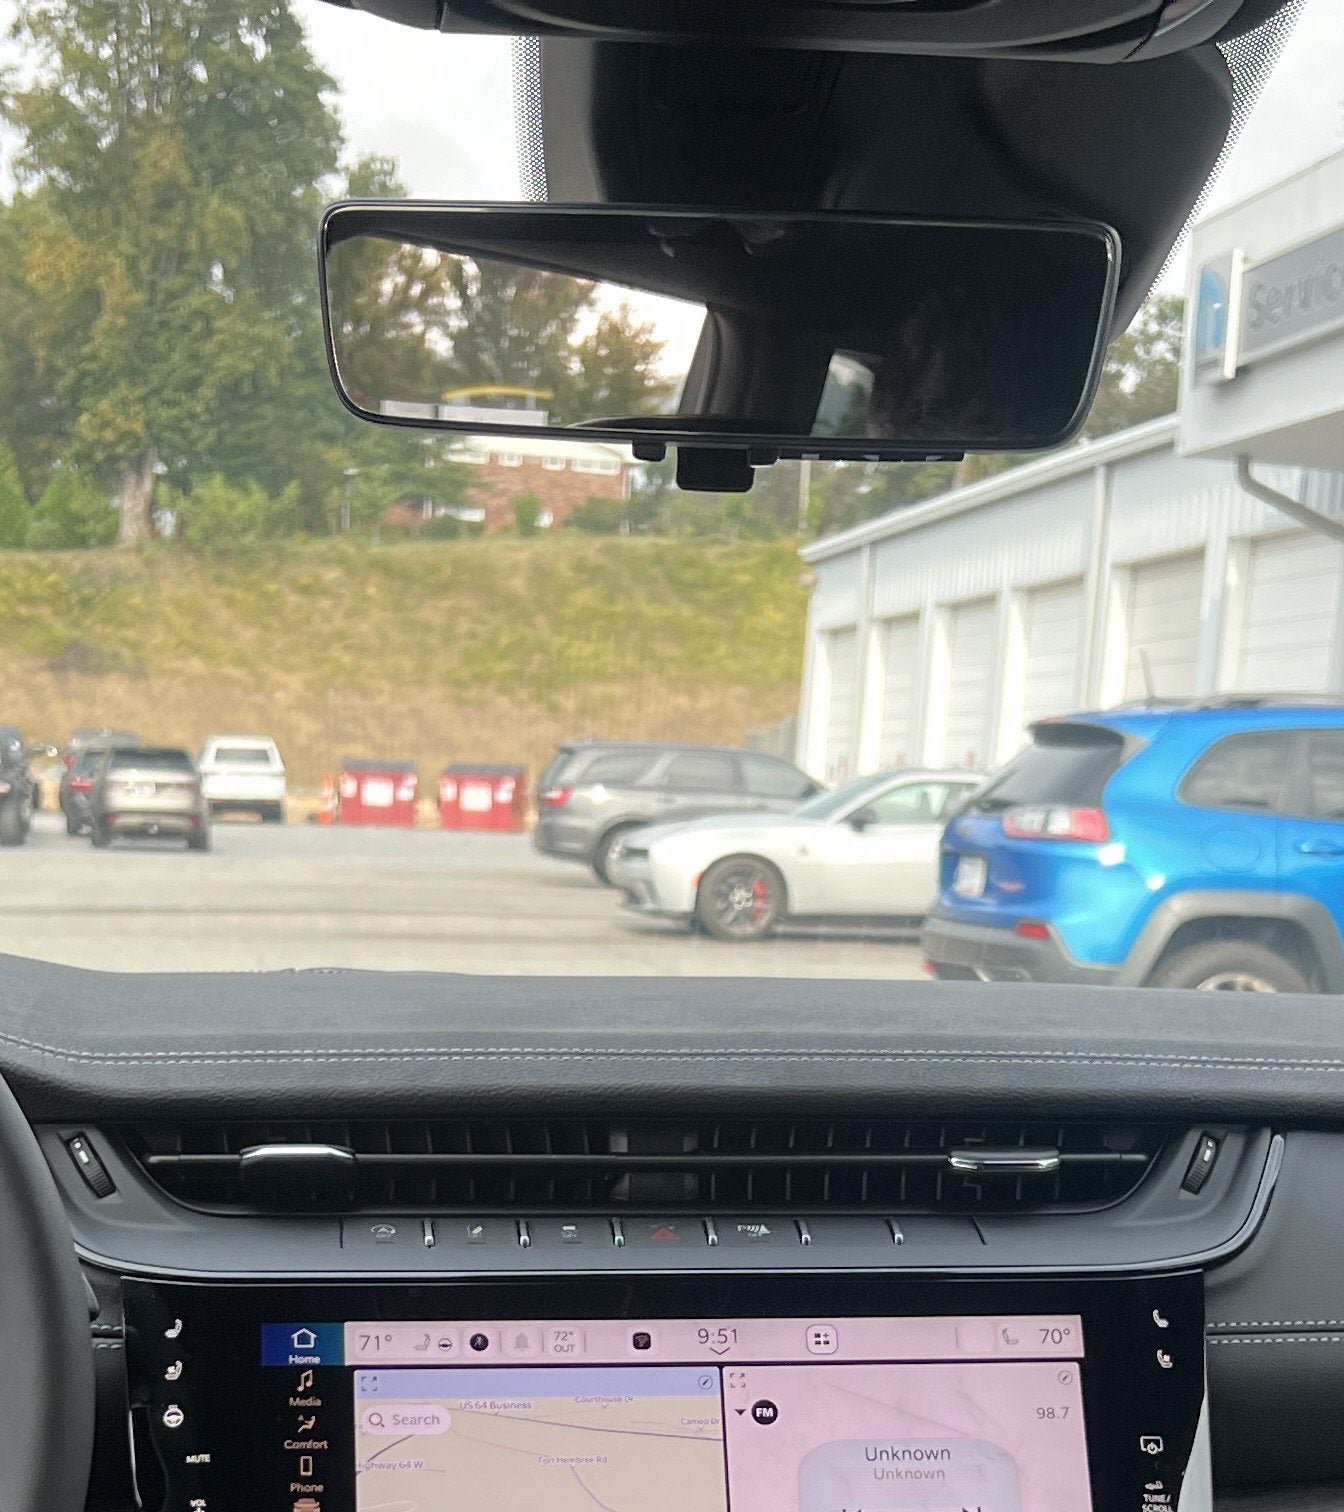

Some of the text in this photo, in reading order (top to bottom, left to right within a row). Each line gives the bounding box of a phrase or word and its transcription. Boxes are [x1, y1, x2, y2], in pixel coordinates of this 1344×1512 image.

[698, 1328, 738, 1344] 9:51
[1039, 1328, 1071, 1345] 70°
[359, 1334, 393, 1351] 71°
[554, 1344, 575, 1353] OUT
[288, 1354, 321, 1365] Home
[289, 1397, 322, 1407] Media
[489, 1401, 532, 1409] Business
[756, 1408, 774, 1418] FM
[1036, 1407, 1070, 1420] 98.7
[392, 1414, 440, 1426] Search
[284, 1439, 329, 1450] Comfort
[186, 1453, 211, 1463] MUTE
[865, 1446, 952, 1462] Unknown
[414, 1461, 424, 1469] W
[873, 1468, 946, 1480] Unknown
[290, 1483, 324, 1493] Phone
[190, 1499, 207, 1507] VOL
